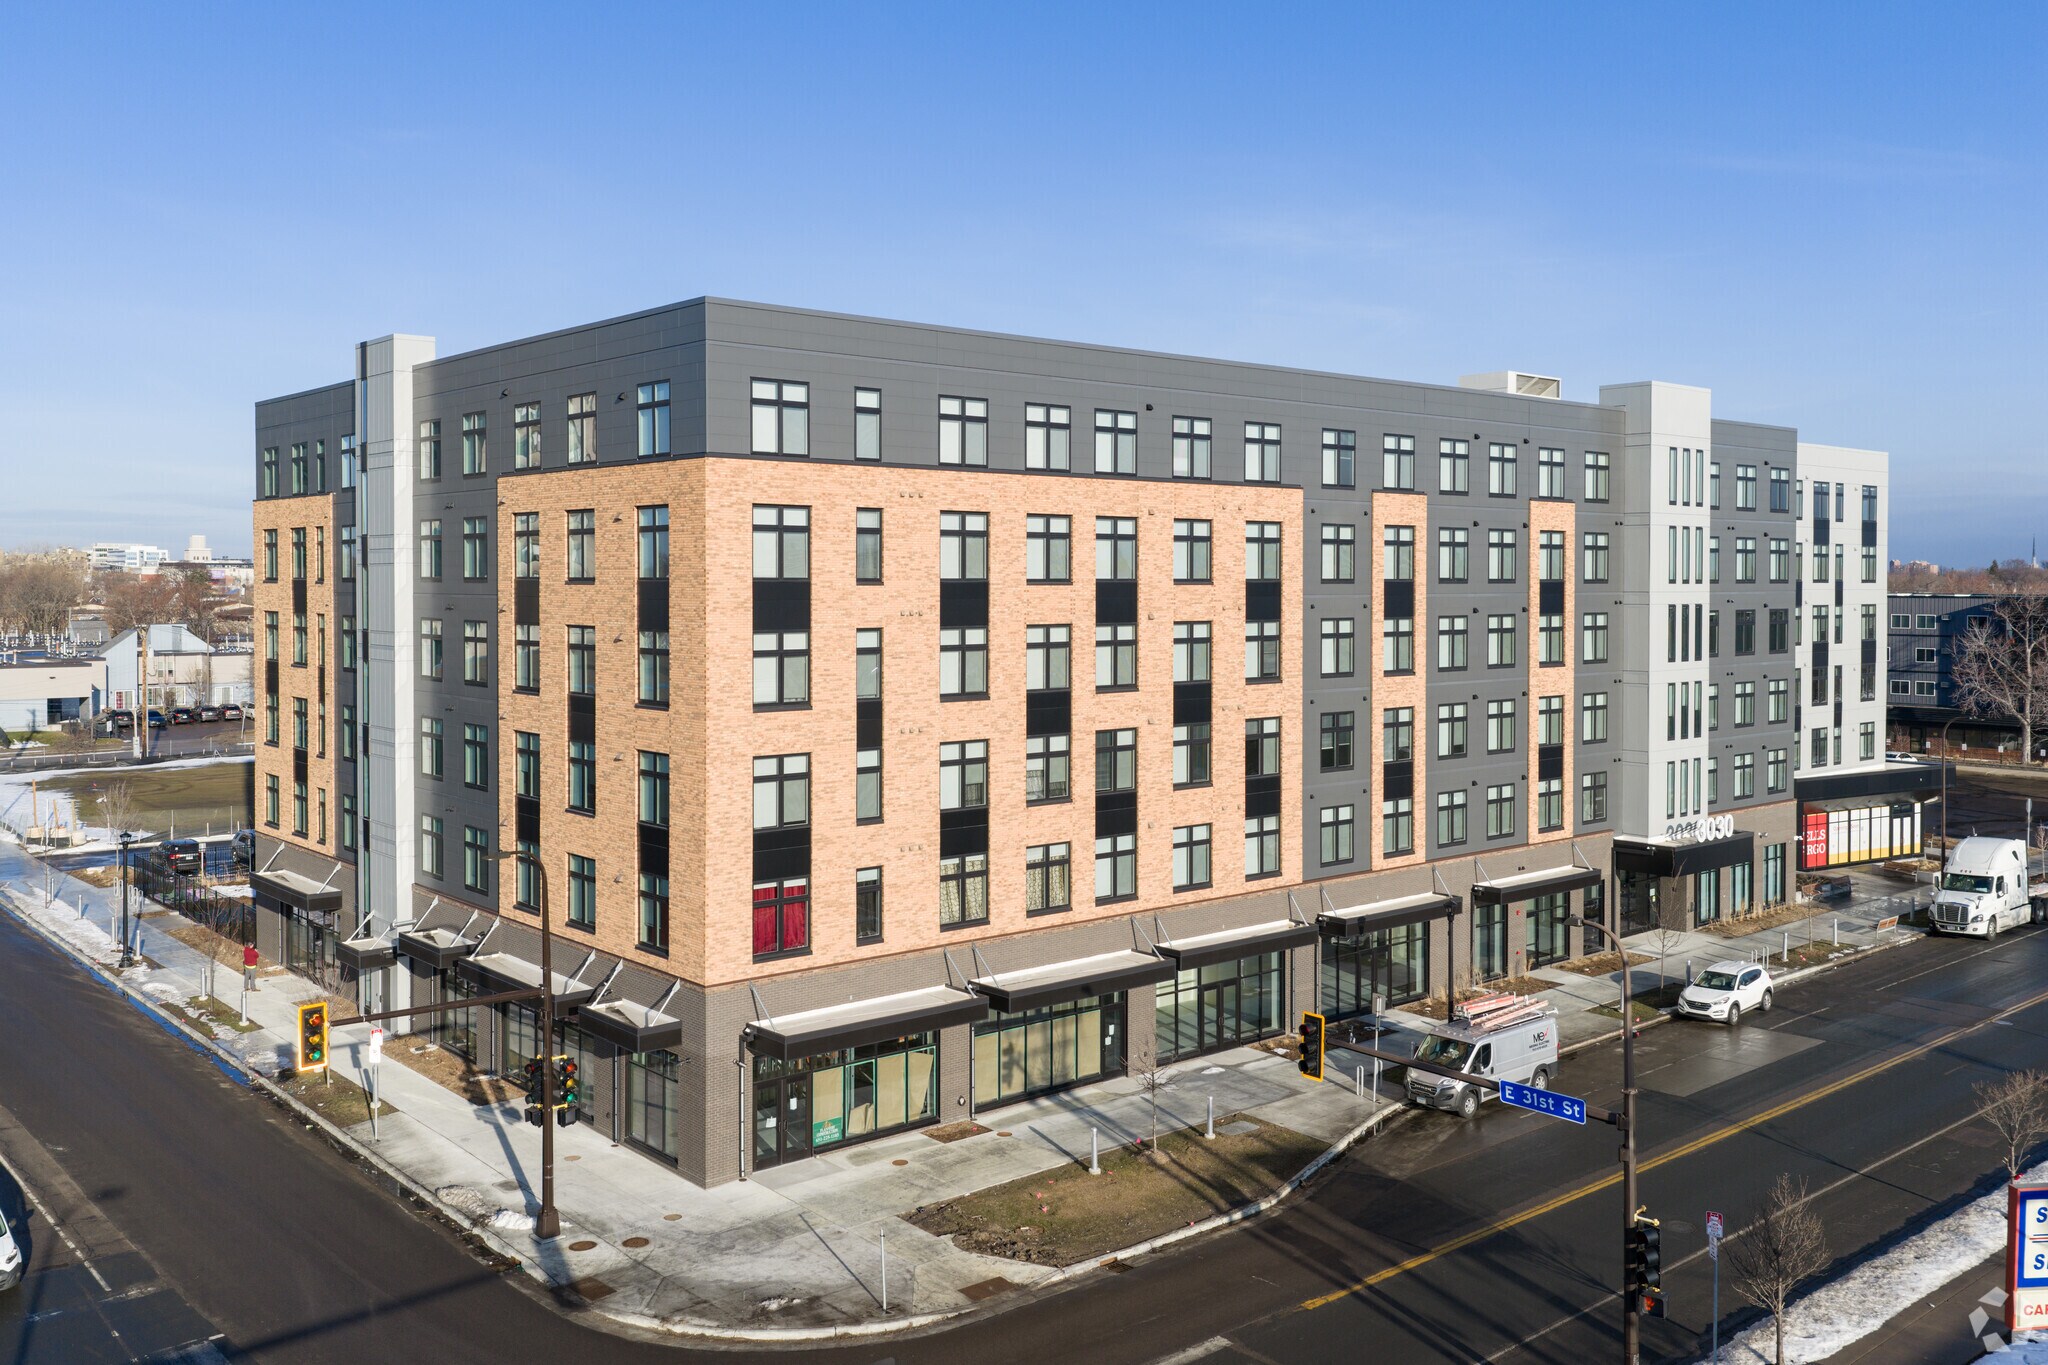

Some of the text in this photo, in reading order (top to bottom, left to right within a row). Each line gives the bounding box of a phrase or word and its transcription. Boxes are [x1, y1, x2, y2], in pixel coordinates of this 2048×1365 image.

[1696, 814, 1734, 843] 3030
[1505, 1085, 1580, 1118] E 31st St
